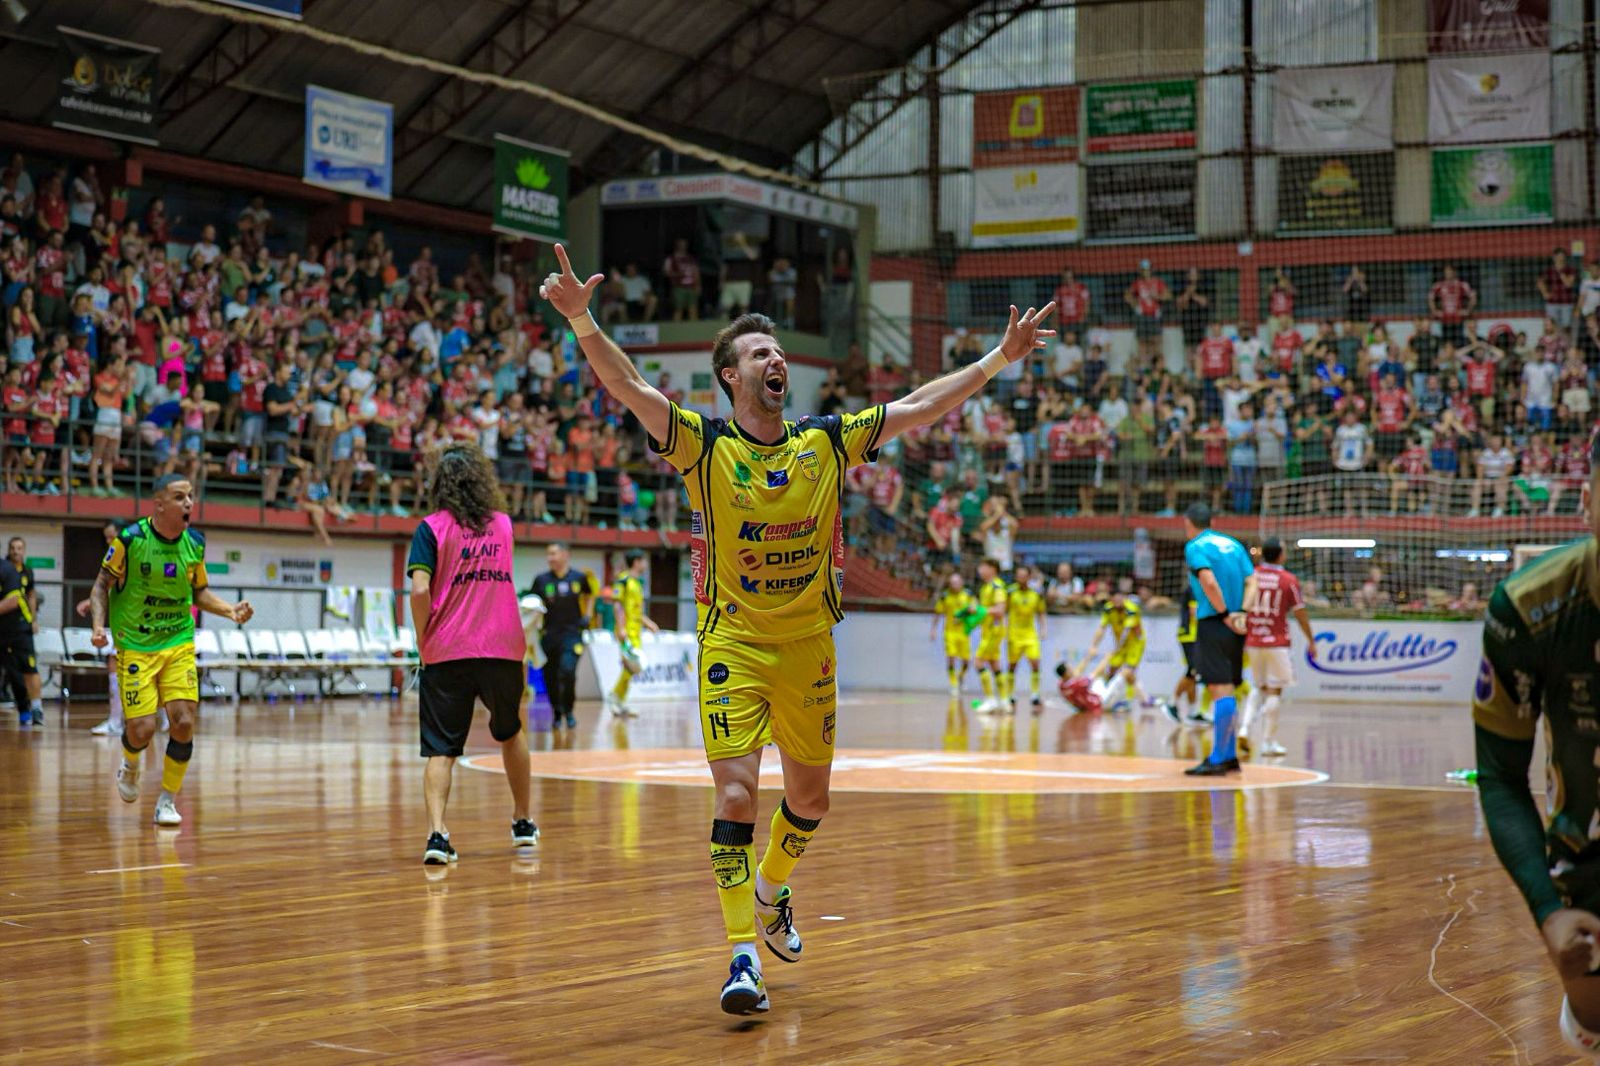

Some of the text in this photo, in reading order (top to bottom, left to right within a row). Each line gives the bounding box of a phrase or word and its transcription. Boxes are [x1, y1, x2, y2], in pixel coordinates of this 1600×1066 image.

[502, 184, 560, 218] MASTER
[766, 546, 820, 565] DIPIL
[708, 711, 731, 740] 14
